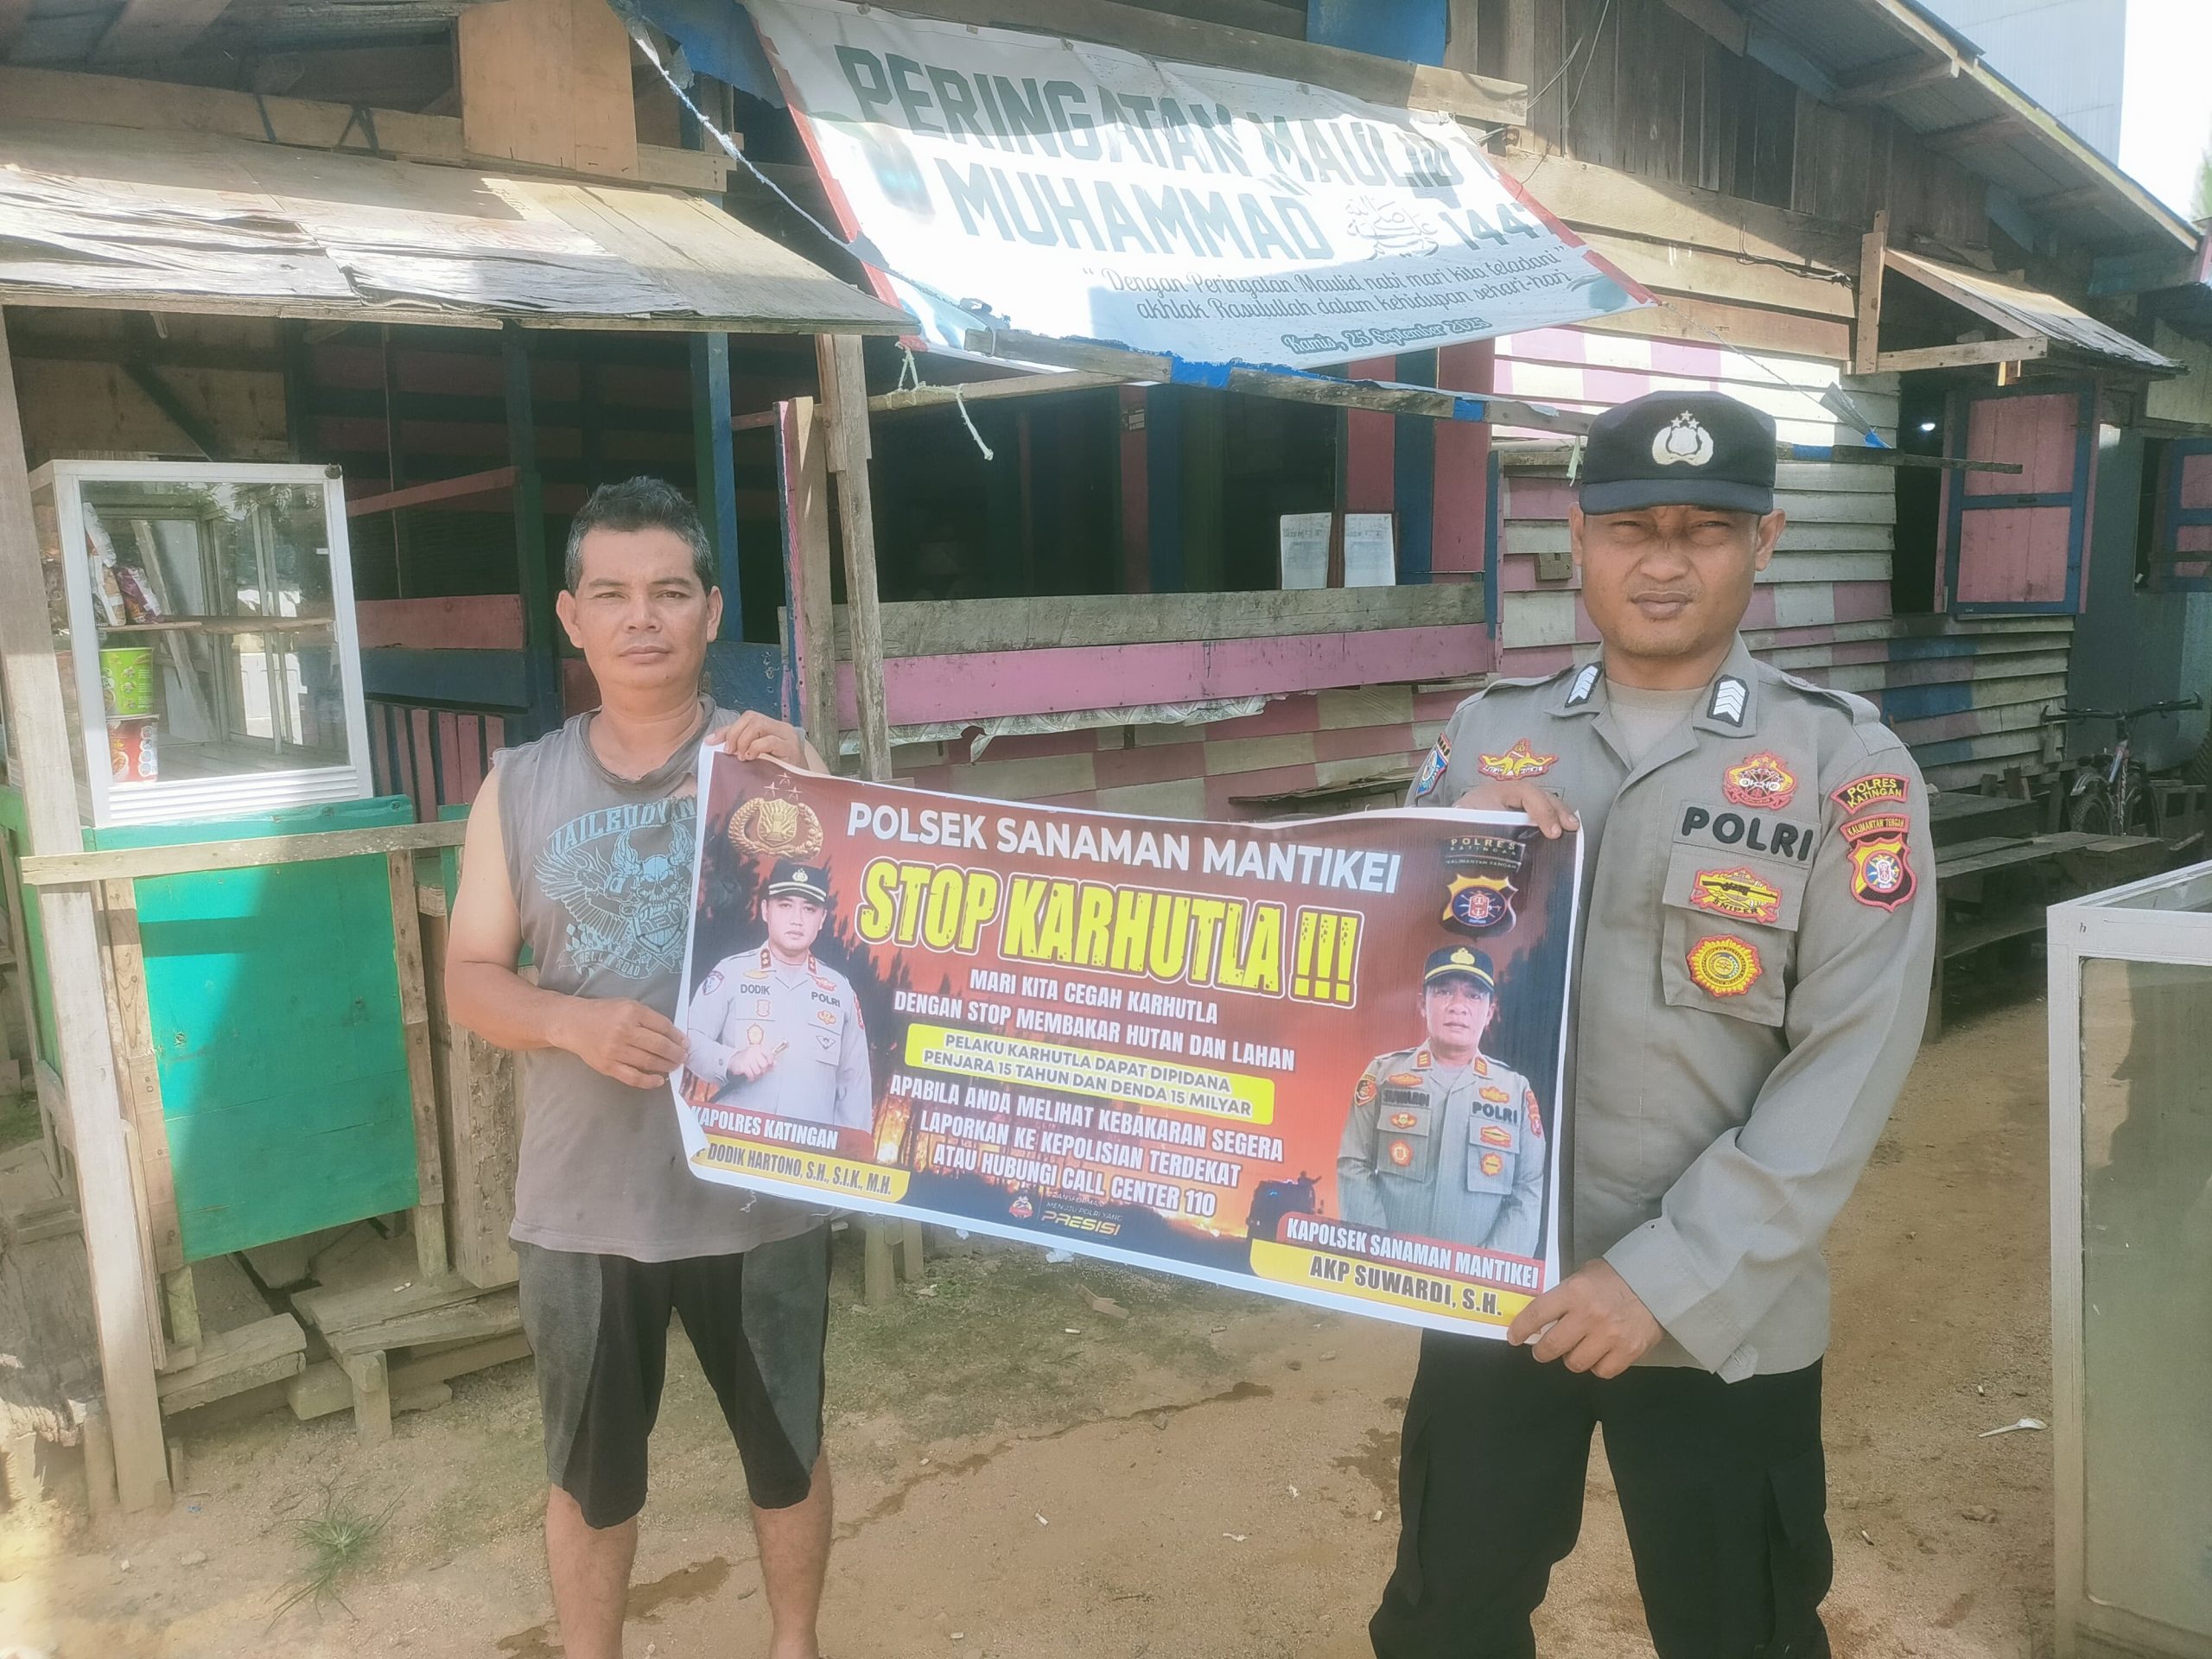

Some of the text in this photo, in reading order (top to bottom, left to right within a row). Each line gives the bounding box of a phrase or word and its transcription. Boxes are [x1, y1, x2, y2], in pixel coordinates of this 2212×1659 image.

[834, 44, 1253, 177] PERINGATAN
[1246, 111, 1465, 188] MAULID
[933, 156, 1335, 260] MUHAMMAD
[1101, 268, 1189, 299] Dengan
[1185, 271, 1297, 299] Peringatan
[1294, 272, 1364, 293] Maulid
[1363, 270, 1406, 290] nabi
[1406, 268, 1450, 288] mari
[1453, 264, 1485, 283] kita
[1136, 269, 1573, 320] akhlak Rasulullah dalam kehidupan sehari-hari
[1342, 329, 1374, 347] 25
[1369, 323, 1448, 347] September
[1444, 316, 1493, 334] 2025
[1847, 778, 1897, 799] POLRES
[1847, 787, 1902, 809] KATINGAN
[847, 801, 1402, 894] POLSEK SANAMAN MANTIKEI
[1451, 837, 1516, 850] POLRES
[1681, 805, 1814, 861] POLRI
[1846, 817, 1905, 837] KALIMANTAN TENGAH
[858, 859, 1001, 952] STOP
[1001, 875, 1284, 995] KARHUTLA
[1713, 898, 1758, 914] SNIPER
[740, 983, 771, 995] DODIK
[810, 991, 841, 1007] POLRI
[969, 969, 1218, 1025] MARI KITA CEGAH KARHUTLA
[893, 990, 1295, 1071] DENGAN STOP MEMBAKAR HUTAN DAN LAHAN
[924, 1050, 1252, 1116] PENJARA 15 TAHUN DAN DENDA 15 MILYAR
[944, 1033, 1230, 1092] PELAKU KARHUTLA DAPAT DIPIDANA
[763, 1118, 839, 1150] KATINGAN
[889, 1074, 1284, 1162] APABILA ANDA MELIHAT KEBAKARAN SEGERA
[1471, 1101, 1518, 1123] POLRI
[707, 1142, 746, 1167] DODIK
[747, 1150, 804, 1179] HARTONO,
[805, 1160, 830, 1185] S.H.,
[866, 1173, 892, 1196] M.H.
[919, 1109, 1242, 1188] LAPORKAN KE KEPOLISIAN TERDEKAT
[933, 1143, 1217, 1217] ATAU HUBUNGI CALL CENTER 110
[1040, 1210, 1122, 1236] PRESISI
[1287, 1217, 1539, 1290] KAPOLSEK SANAMAN MANTIKEI
[1309, 1255, 1503, 1317] AKP SUWARDI, S.H.
